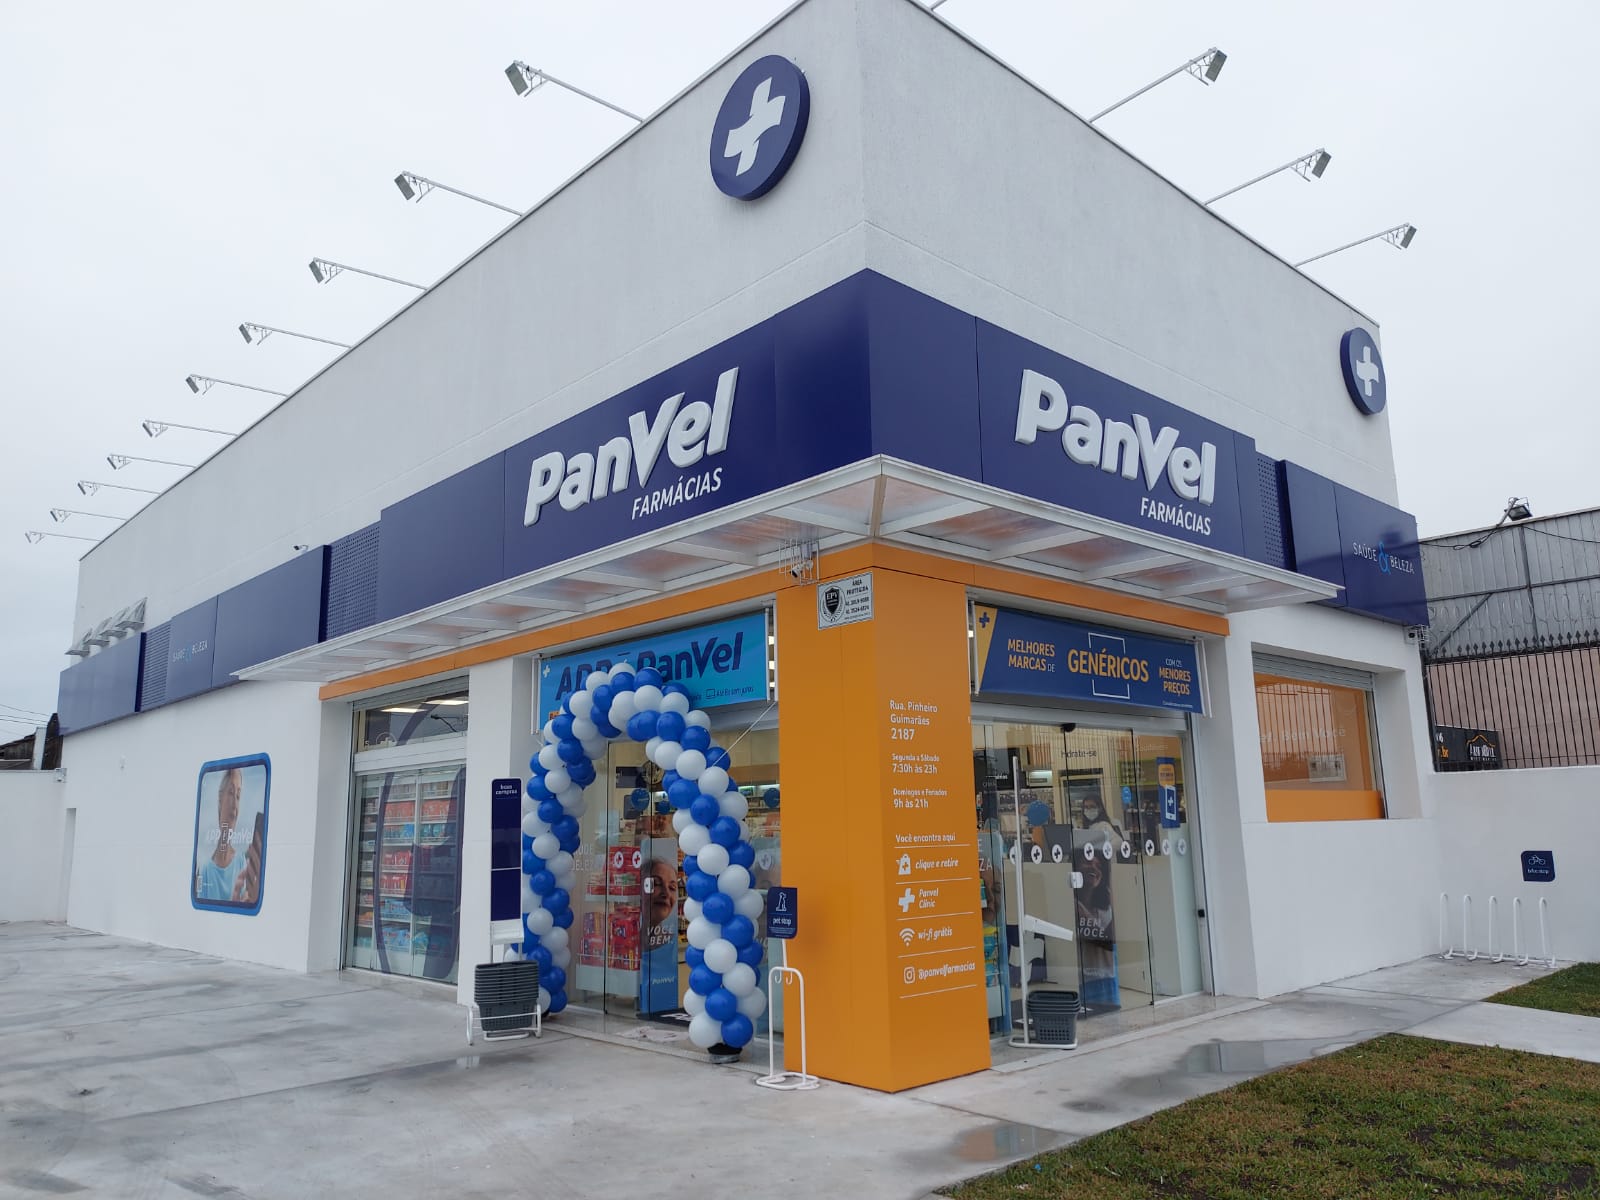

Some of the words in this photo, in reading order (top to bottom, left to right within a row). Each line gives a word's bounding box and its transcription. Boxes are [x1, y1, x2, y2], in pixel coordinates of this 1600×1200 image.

[1015, 369, 1216, 506] PanVel
[524, 367, 738, 527] PanVel
[631, 467, 722, 520] FARMÁCIAS
[1140, 497, 1211, 535] FARMÁCIAS
[1353, 542, 1377, 562] SAÚDE
[1390, 555, 1415, 574] BELEZA
[1007, 638, 1055, 657] MELHORES
[1008, 654, 1046, 672] MARCAS
[1047, 663, 1055, 673] DE
[1067, 648, 1149, 683] GENÉRICOS
[1165, 658, 1175, 667] COM
[1159, 666, 1191, 682] MENORES
[1163, 681, 1190, 696] PREÇOS
[907, 701, 938, 713] Pinheiro
[890, 713, 930, 726] Guimarães
[891, 728, 915, 740] 2187
[892, 763, 913, 773] 7:30h
[924, 764, 938, 774] 23h
[893, 798, 903, 808] 9h
[914, 799, 929, 808] 21h
[895, 834, 912, 843] Você
[913, 834, 941, 843] encontra
[942, 834, 956, 844] aqui
[915, 859, 935, 871] clique
[772, 918, 781, 926] pet
[781, 918, 791, 927] stop
[918, 927, 933, 941] wi-fi
[933, 927, 953, 940] grátis
